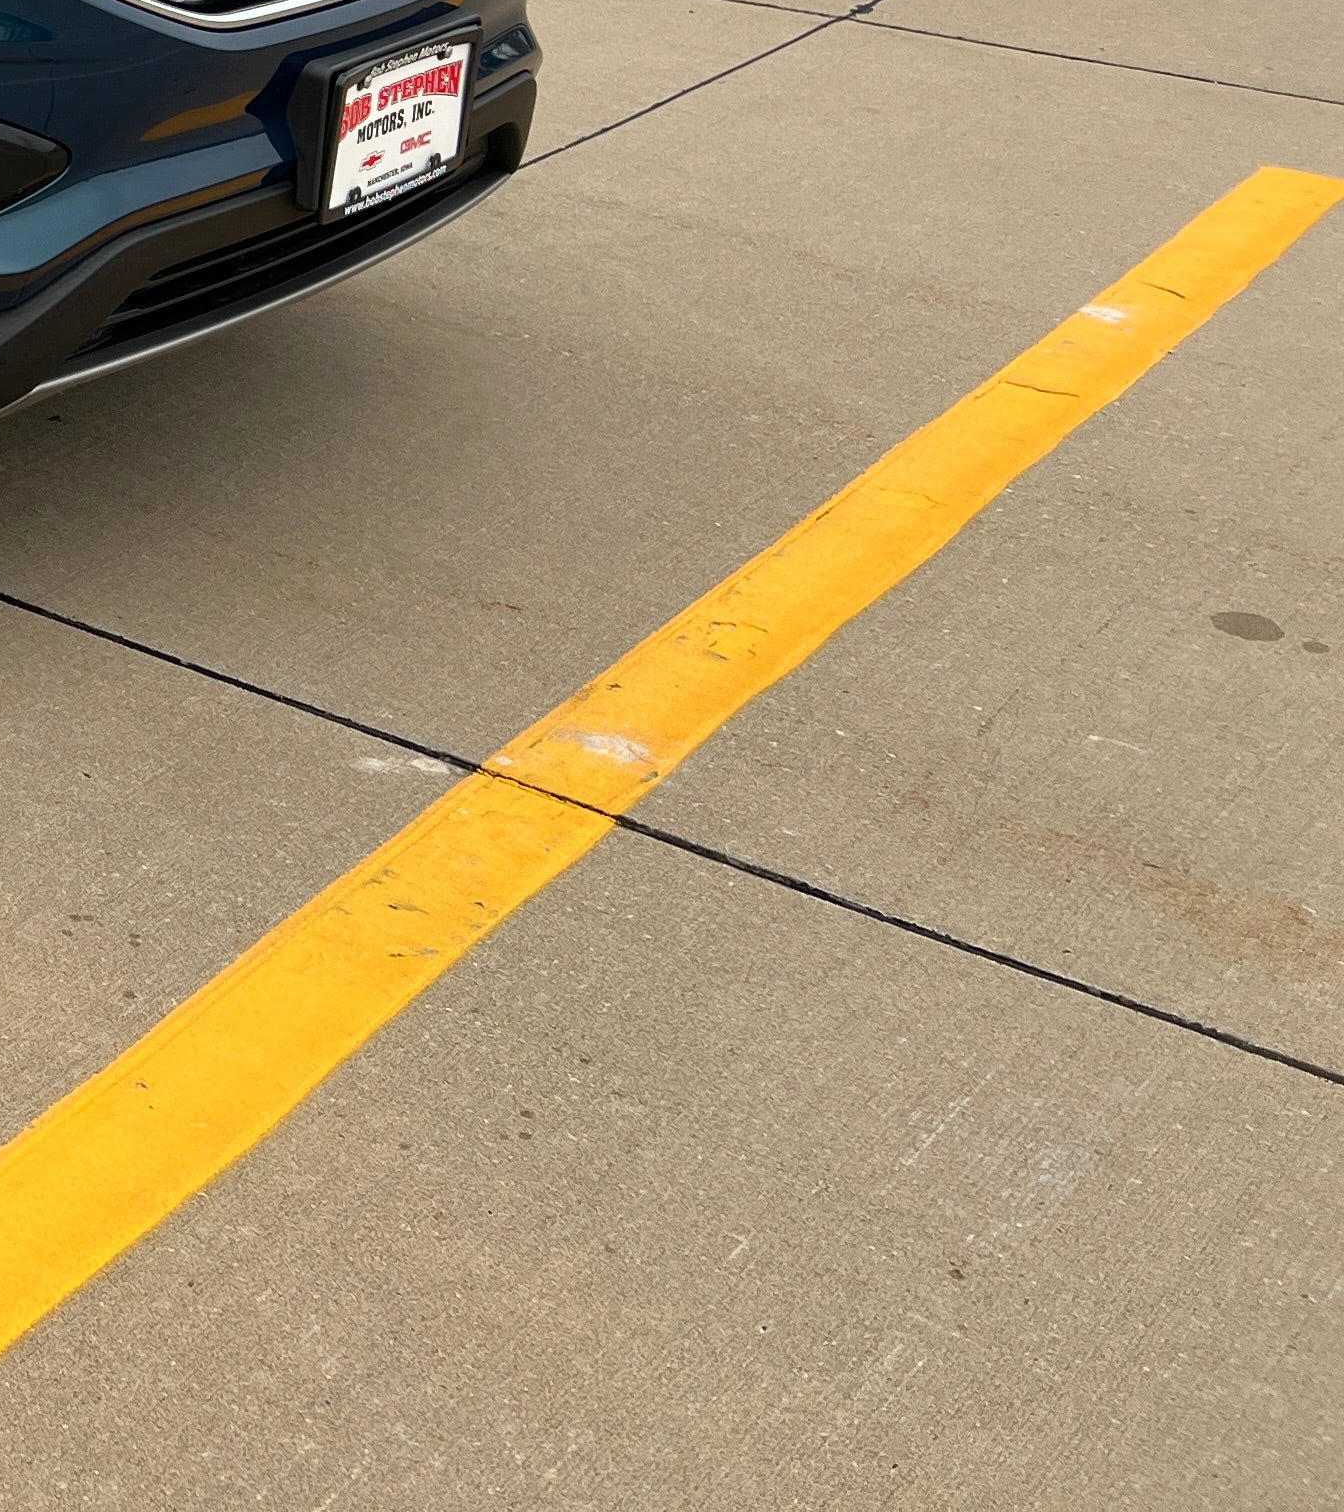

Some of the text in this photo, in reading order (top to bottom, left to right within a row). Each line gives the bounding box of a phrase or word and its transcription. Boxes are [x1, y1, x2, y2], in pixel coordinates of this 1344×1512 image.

[338, 60, 464, 144] BOB STEPHEN
[356, 100, 436, 144] MOTORS, INC.
[400, 131, 432, 155] GMC
